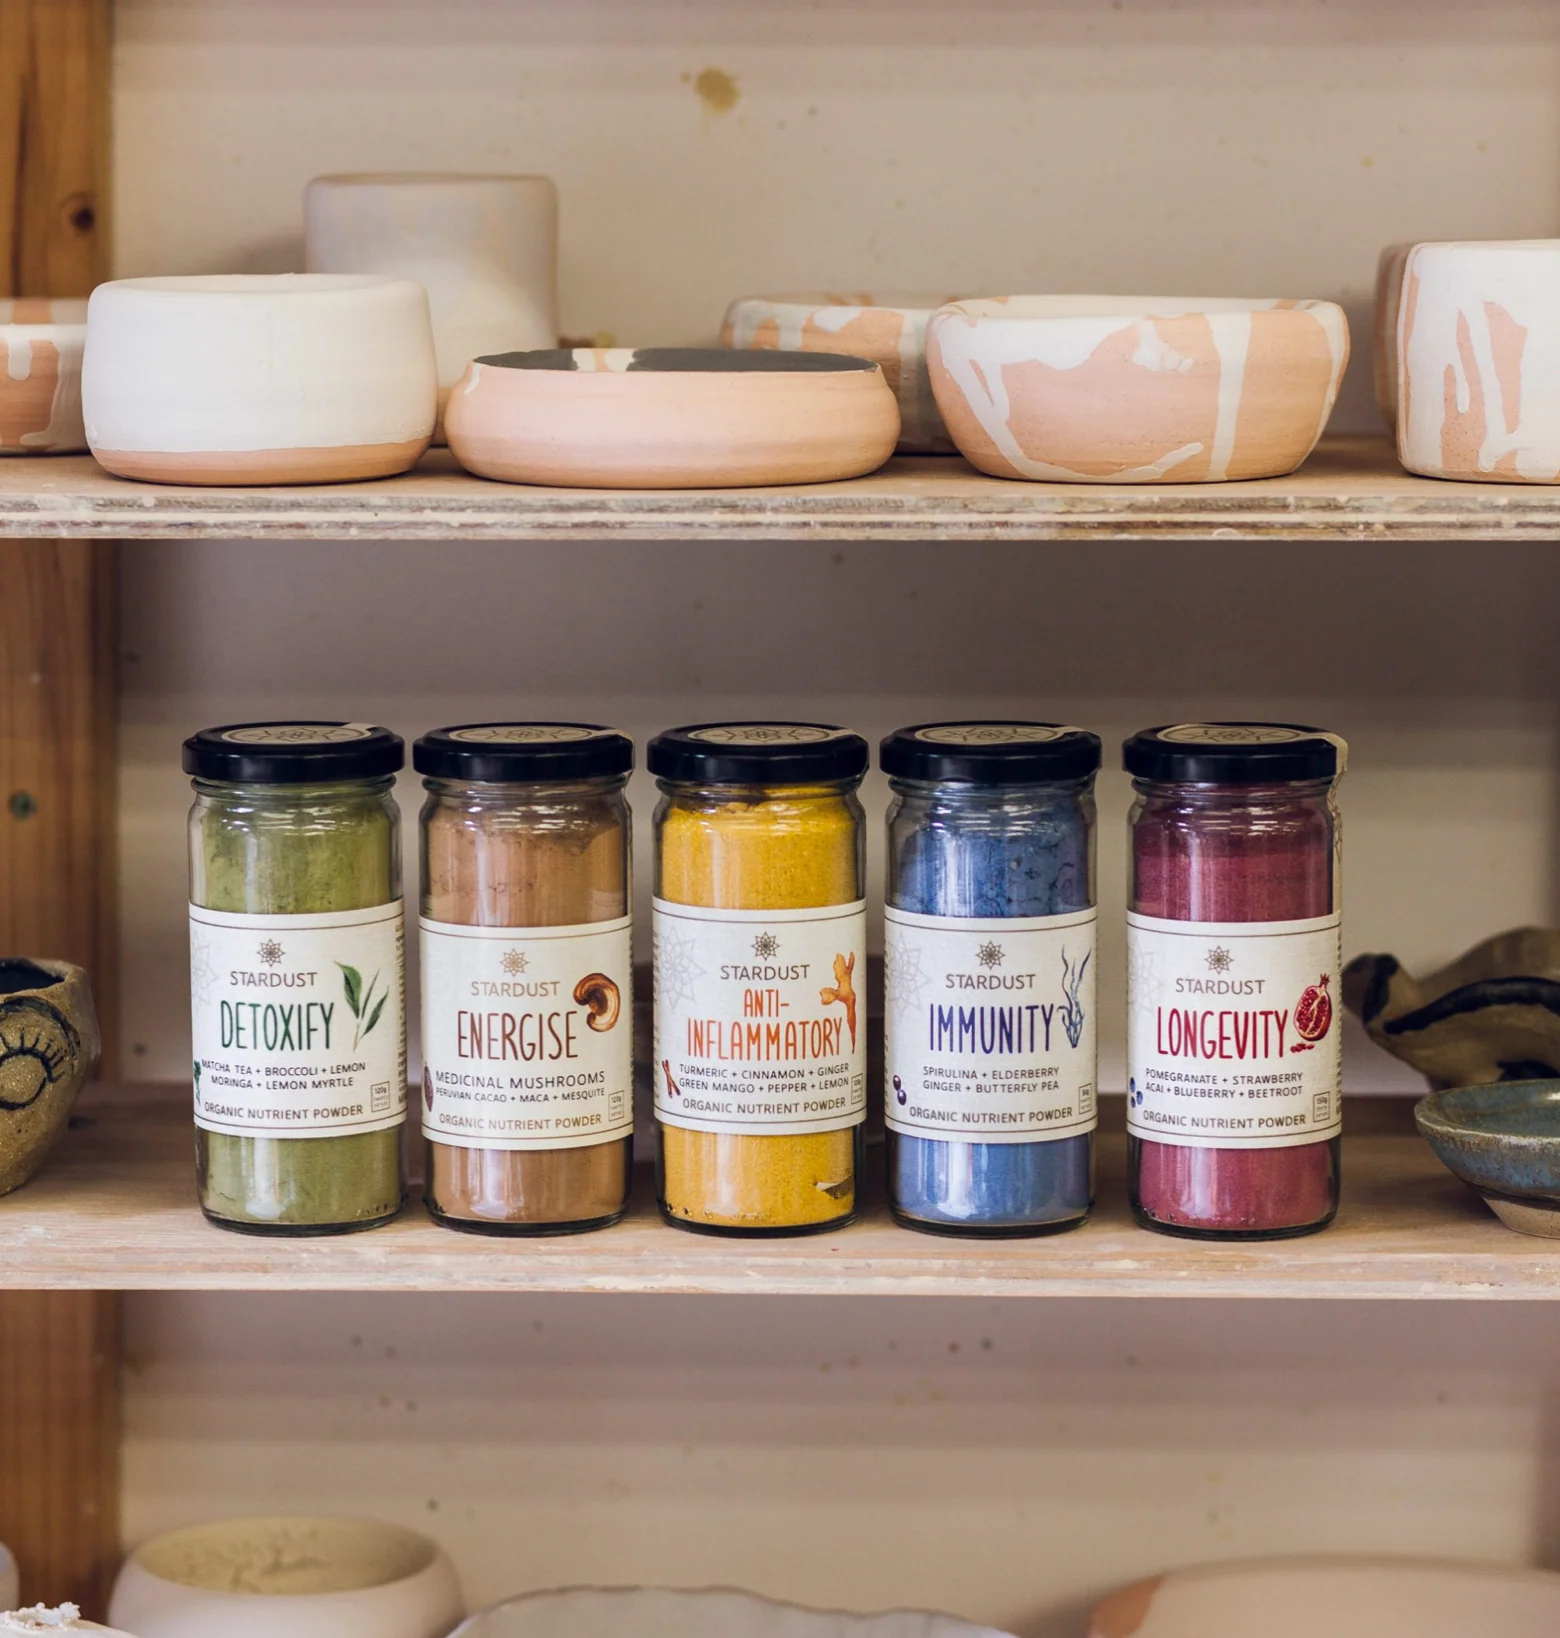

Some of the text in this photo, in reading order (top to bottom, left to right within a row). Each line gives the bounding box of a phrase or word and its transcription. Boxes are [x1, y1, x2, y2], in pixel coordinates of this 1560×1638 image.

[230, 971, 318, 988] STARDUST
[720, 964, 810, 981] STARDUST
[471, 981, 560, 997] STARDUST
[945, 974, 1036, 990] STARDUST
[1176, 978, 1265, 995] STARDUST
[743, 988, 789, 1018] ANTI-
[220, 1000, 334, 1051] DETOXIFY
[930, 1003, 1055, 1054] IMMUNITY
[1157, 1006, 1288, 1060] LONGEVITY
[457, 1010, 579, 1061] ENERGISE
[687, 1017, 842, 1061] INFLAMMATORY
[201, 1059, 230, 1073] MATCHA
[235, 1065, 253, 1075] TEA
[265, 1067, 318, 1076] BROCCOLI
[330, 1062, 366, 1074] LEMON
[679, 1064, 727, 1078] TURMERIC
[741, 1069, 804, 1080] CINNAMON
[817, 1063, 849, 1076] GINGER
[923, 1066, 977, 1079] SPIRULINA
[992, 1067, 1059, 1080] ELDERBERRY
[211, 1076, 253, 1089] MORINGA
[266, 1080, 307, 1090] LEMON
[312, 1077, 353, 1088] MYRTLE
[435, 1070, 605, 1089] MEDICINAL MUSHROOMS
[679, 1077, 708, 1090] GREEN
[712, 1083, 755, 1093] MANGO
[768, 1082, 807, 1093] PEPPER
[819, 1077, 849, 1089] LEMON
[1145, 1068, 1218, 1084] POMEGRANATE
[1233, 1072, 1303, 1085] STRAWBERRY
[436, 1088, 471, 1100] PERUVIAN
[474, 1092, 506, 1103] CACAO
[519, 1093, 549, 1102] MACA
[562, 1087, 605, 1101] MESQUITE
[923, 1081, 962, 1092] GINGER
[976, 1083, 1038, 1093] BUTTERFLY
[1042, 1081, 1059, 1090] PEA
[1145, 1082, 1164, 1093] ACAI
[1174, 1087, 1235, 1099] BLUEBERRY
[1248, 1086, 1303, 1098] BEETROOT
[204, 1102, 363, 1120] ORGANIC NUTRIENT POWDER
[683, 1097, 846, 1114] ORGANIC NUTRIENT POWDER
[439, 1113, 602, 1130] ORGANIC NUTRIENT POWDER
[910, 1106, 1073, 1123] ORGANIC NUTRIENT POWDER
[1143, 1110, 1306, 1129] ORGANIC NUTRIENT POWDER
